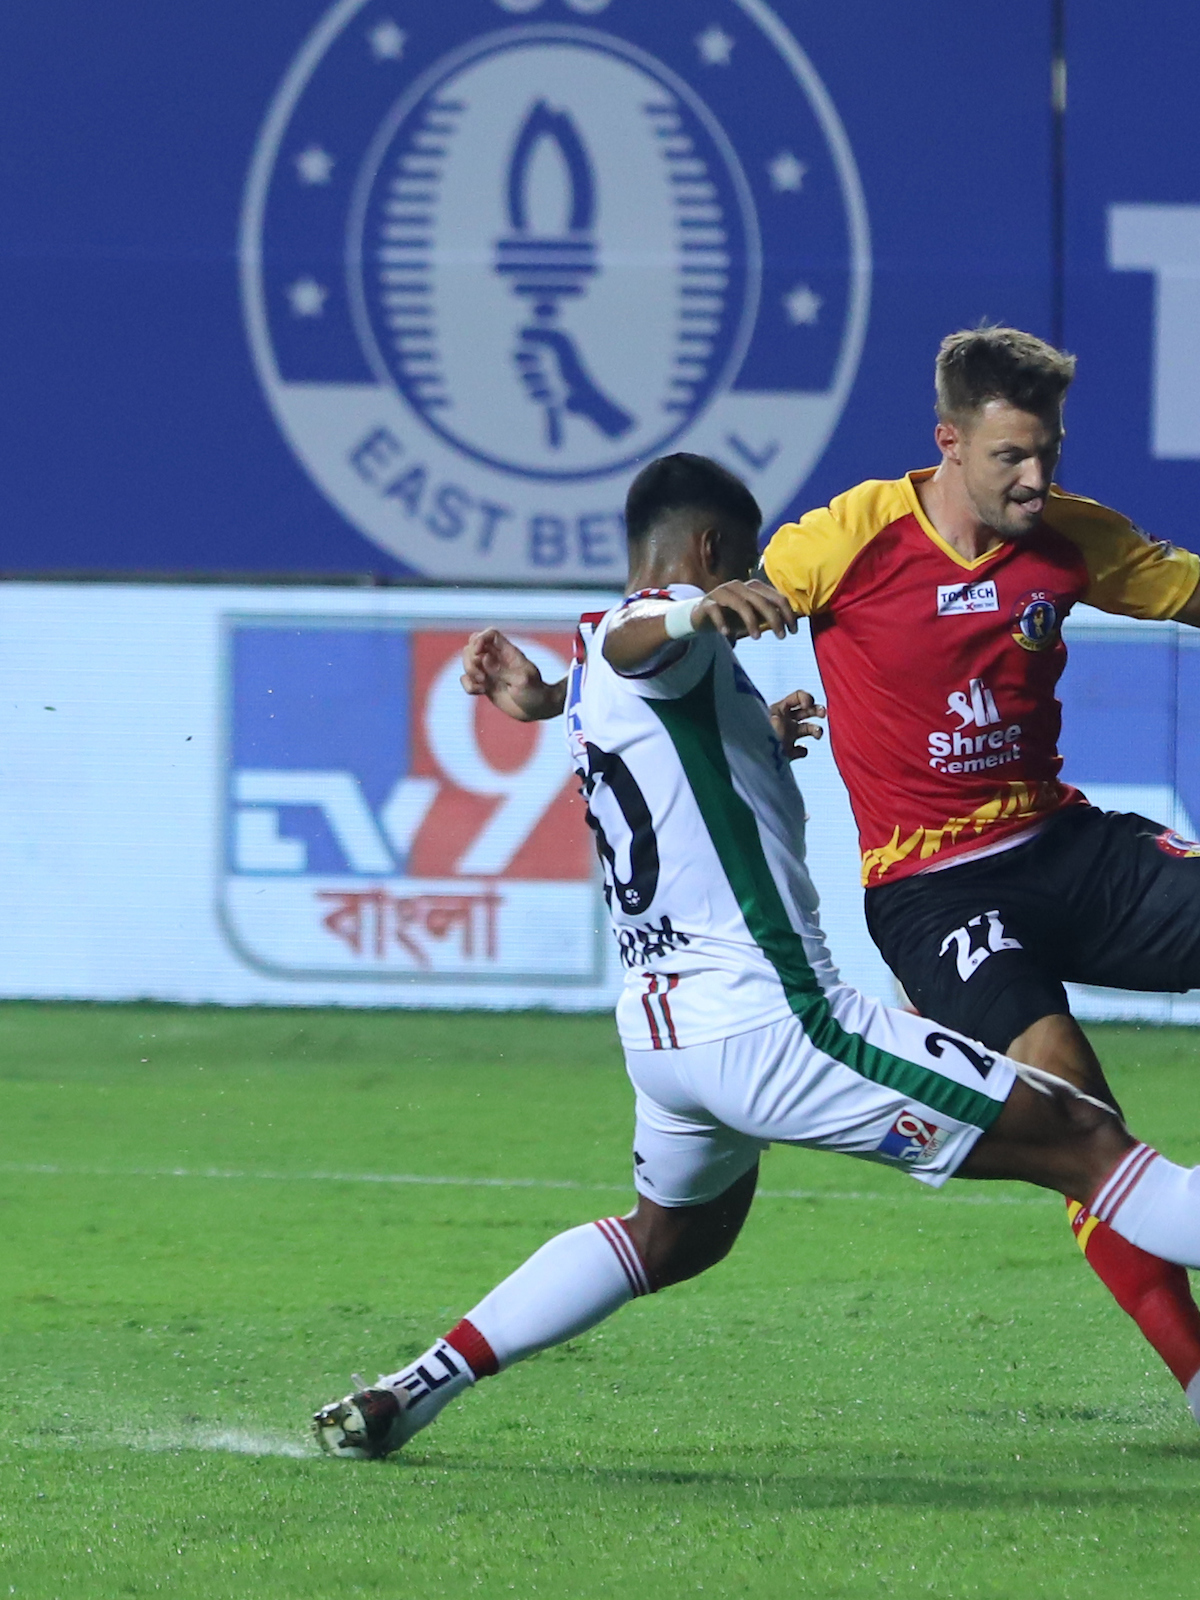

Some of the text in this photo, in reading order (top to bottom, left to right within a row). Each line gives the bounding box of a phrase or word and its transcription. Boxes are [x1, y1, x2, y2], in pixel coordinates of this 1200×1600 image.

[347, 424, 514, 556] EAST
[235, 636, 580, 876] TV9
[927, 724, 1022, 757] Shree
[929, 744, 1021, 774] Cement
[316, 885, 504, 970] বাংলা
[939, 909, 1024, 982] 22
